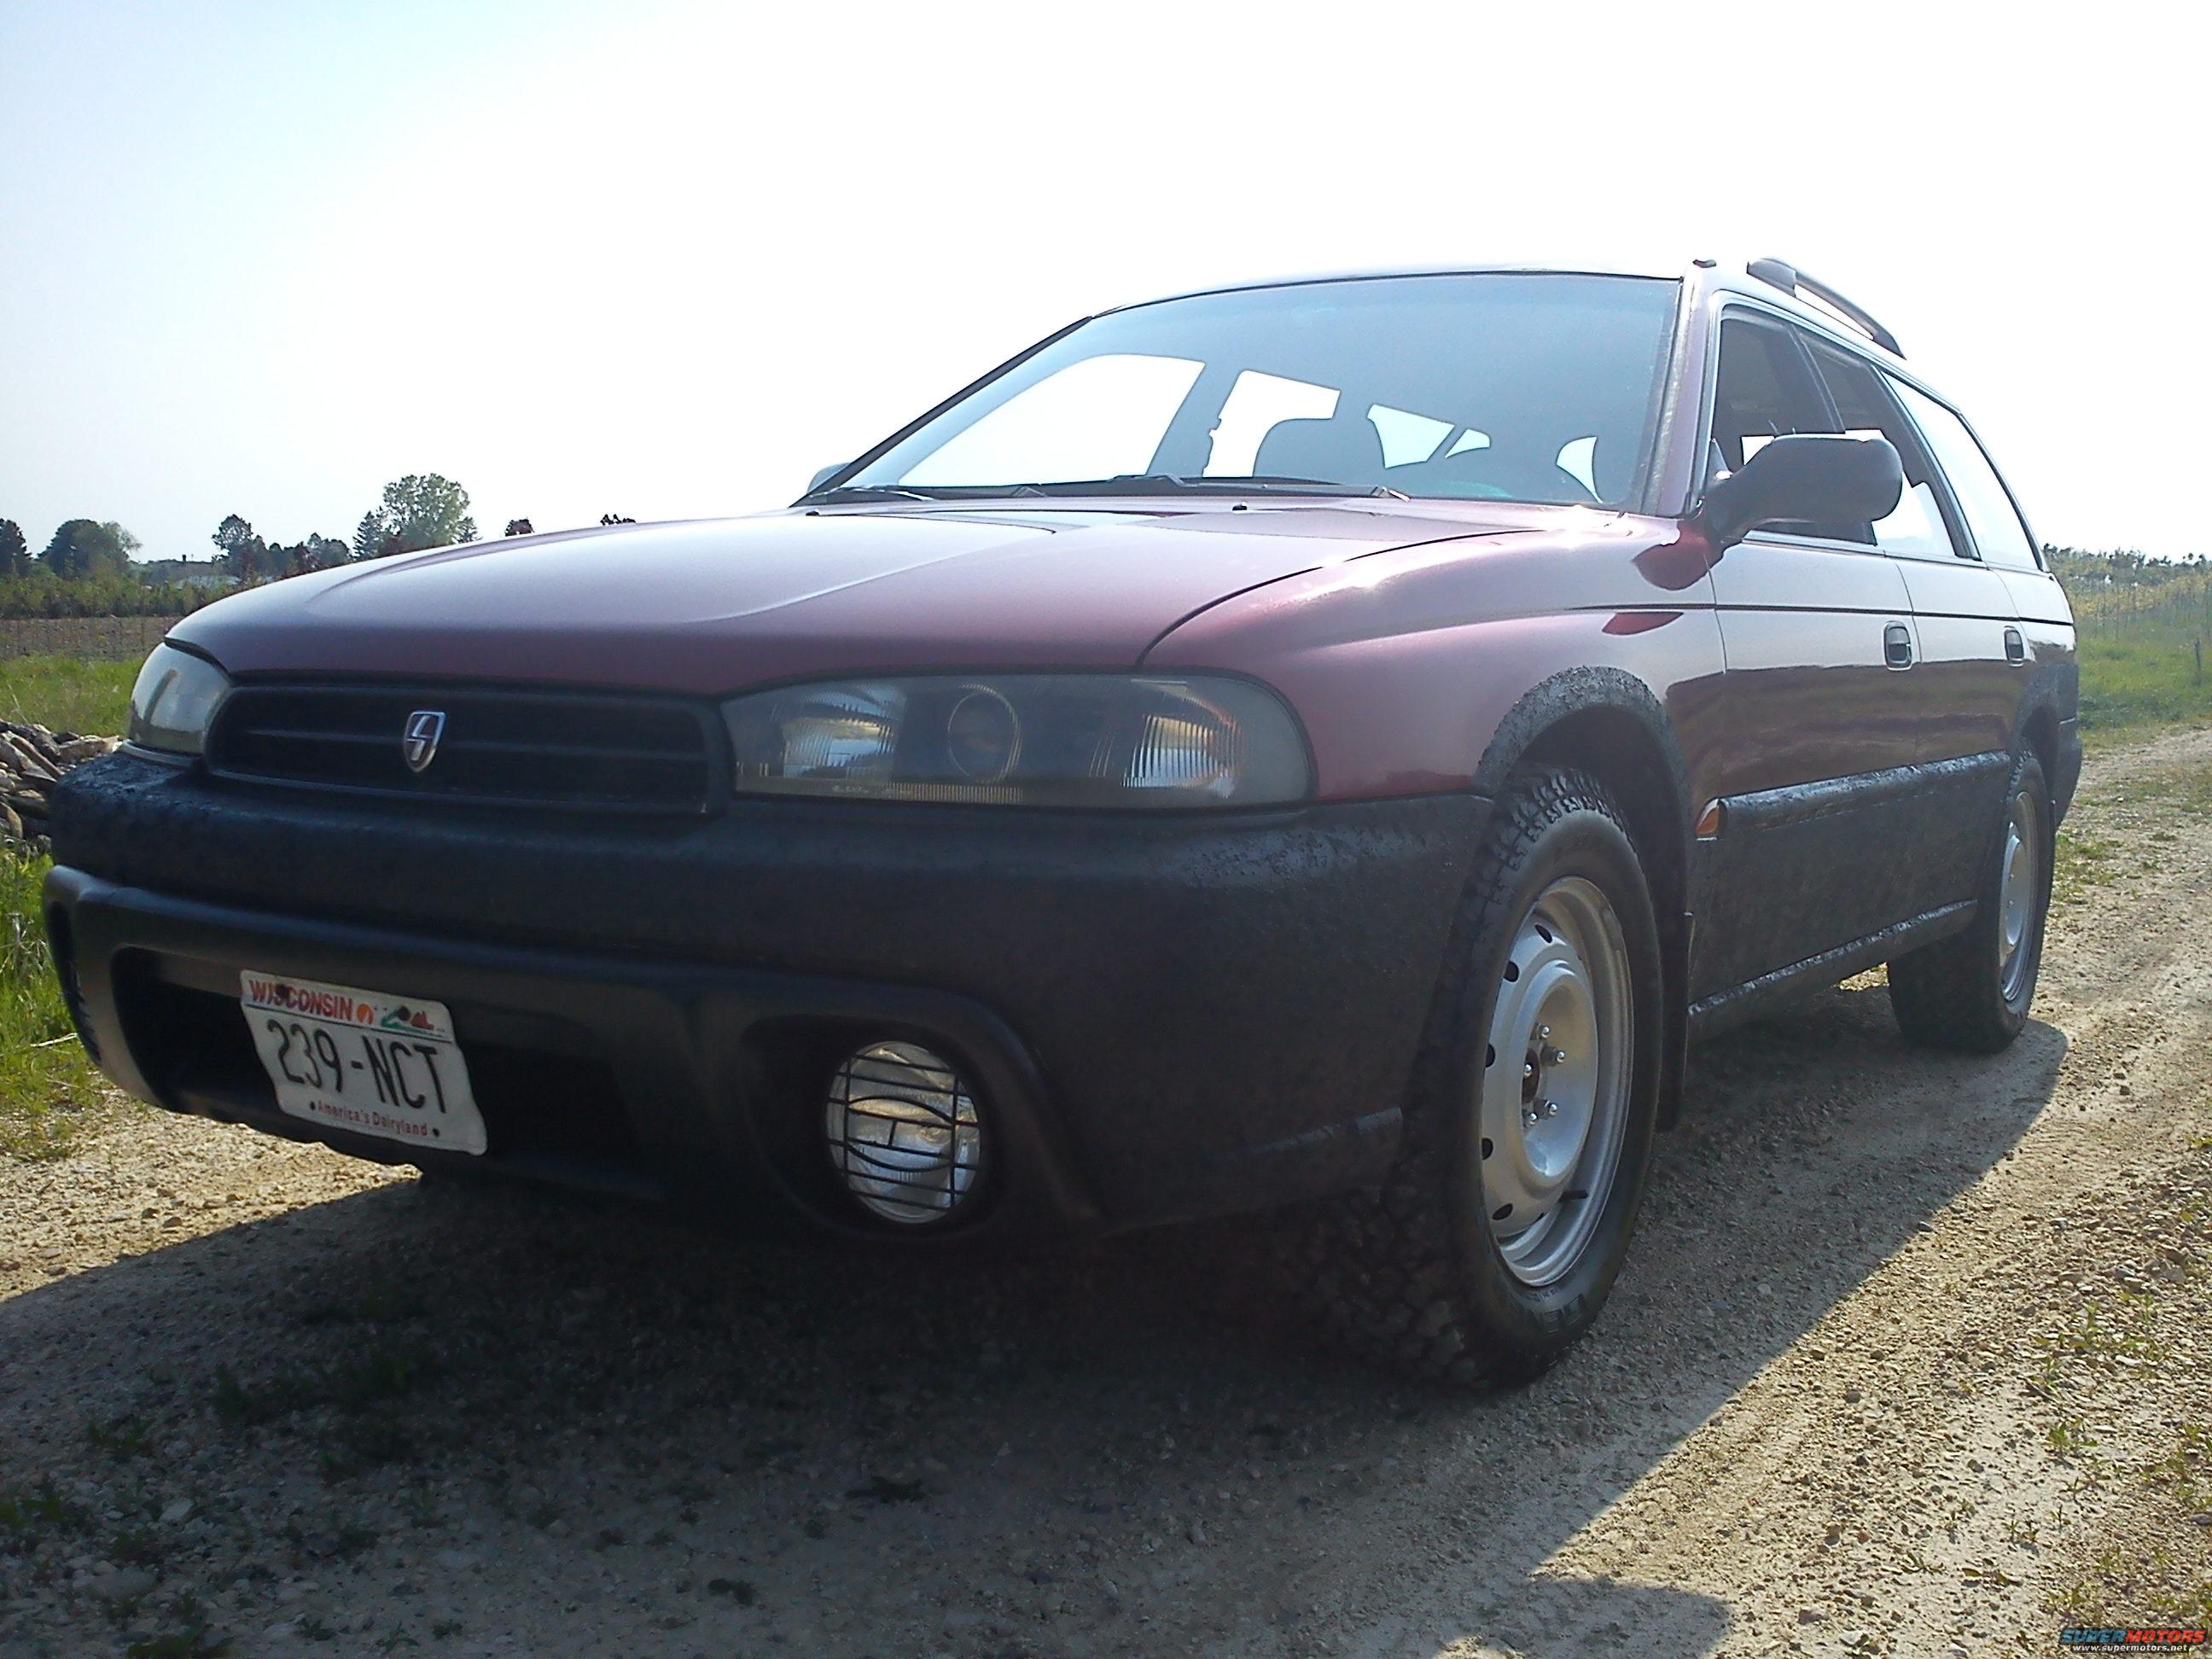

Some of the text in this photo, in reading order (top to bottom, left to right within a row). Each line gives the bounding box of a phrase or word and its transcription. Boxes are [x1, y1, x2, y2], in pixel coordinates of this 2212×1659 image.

[249, 980, 353, 1022] WISCONSIN
[267, 1019, 445, 1114] 239-NCT
[317, 1101, 428, 1136] America's Dairyland
